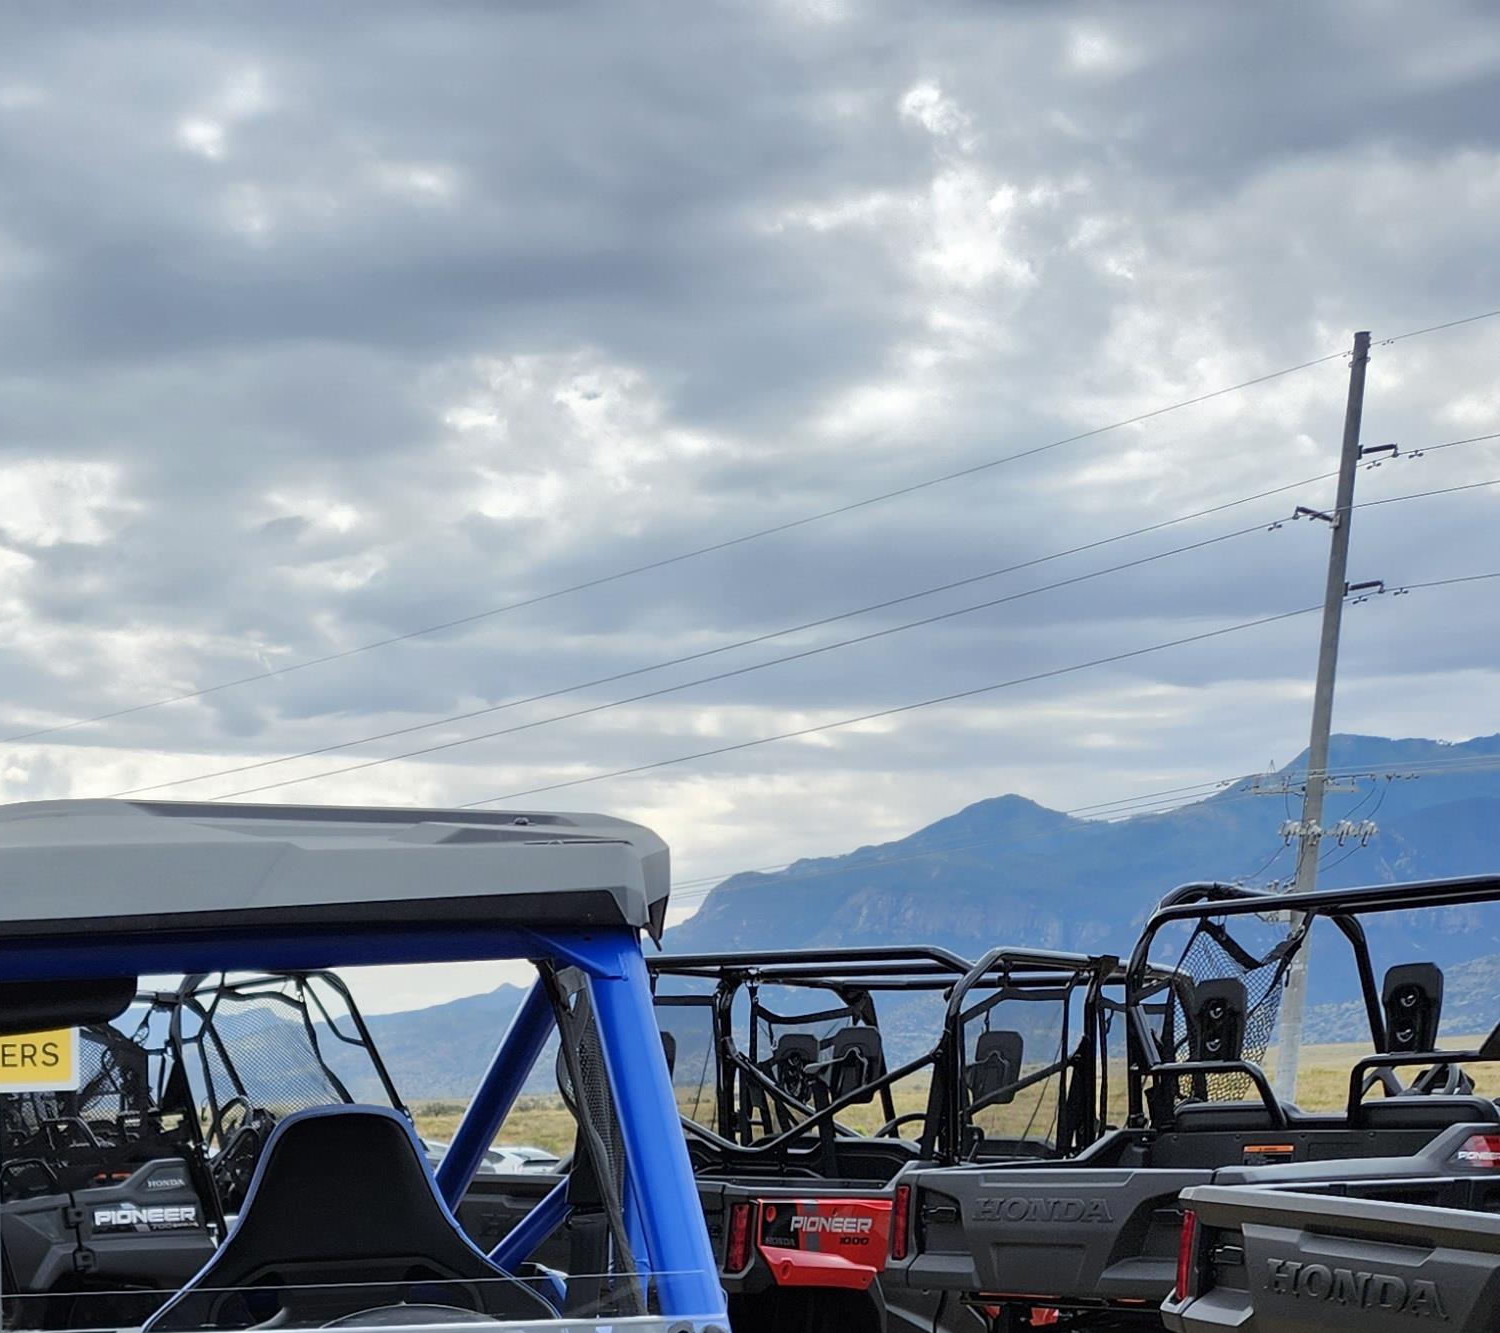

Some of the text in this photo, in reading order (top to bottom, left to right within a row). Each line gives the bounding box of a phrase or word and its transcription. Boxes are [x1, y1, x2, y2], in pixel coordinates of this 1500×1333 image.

[147, 1178, 185, 1188] HONDA
[94, 1207, 197, 1226] PIONEER
[972, 1197, 1114, 1223] HONDA
[790, 1216, 873, 1233] PIONEER
[765, 1236, 797, 1247] HONDA
[840, 1236, 869, 1246] 1000
[1262, 1258, 1449, 1320] HONDA
